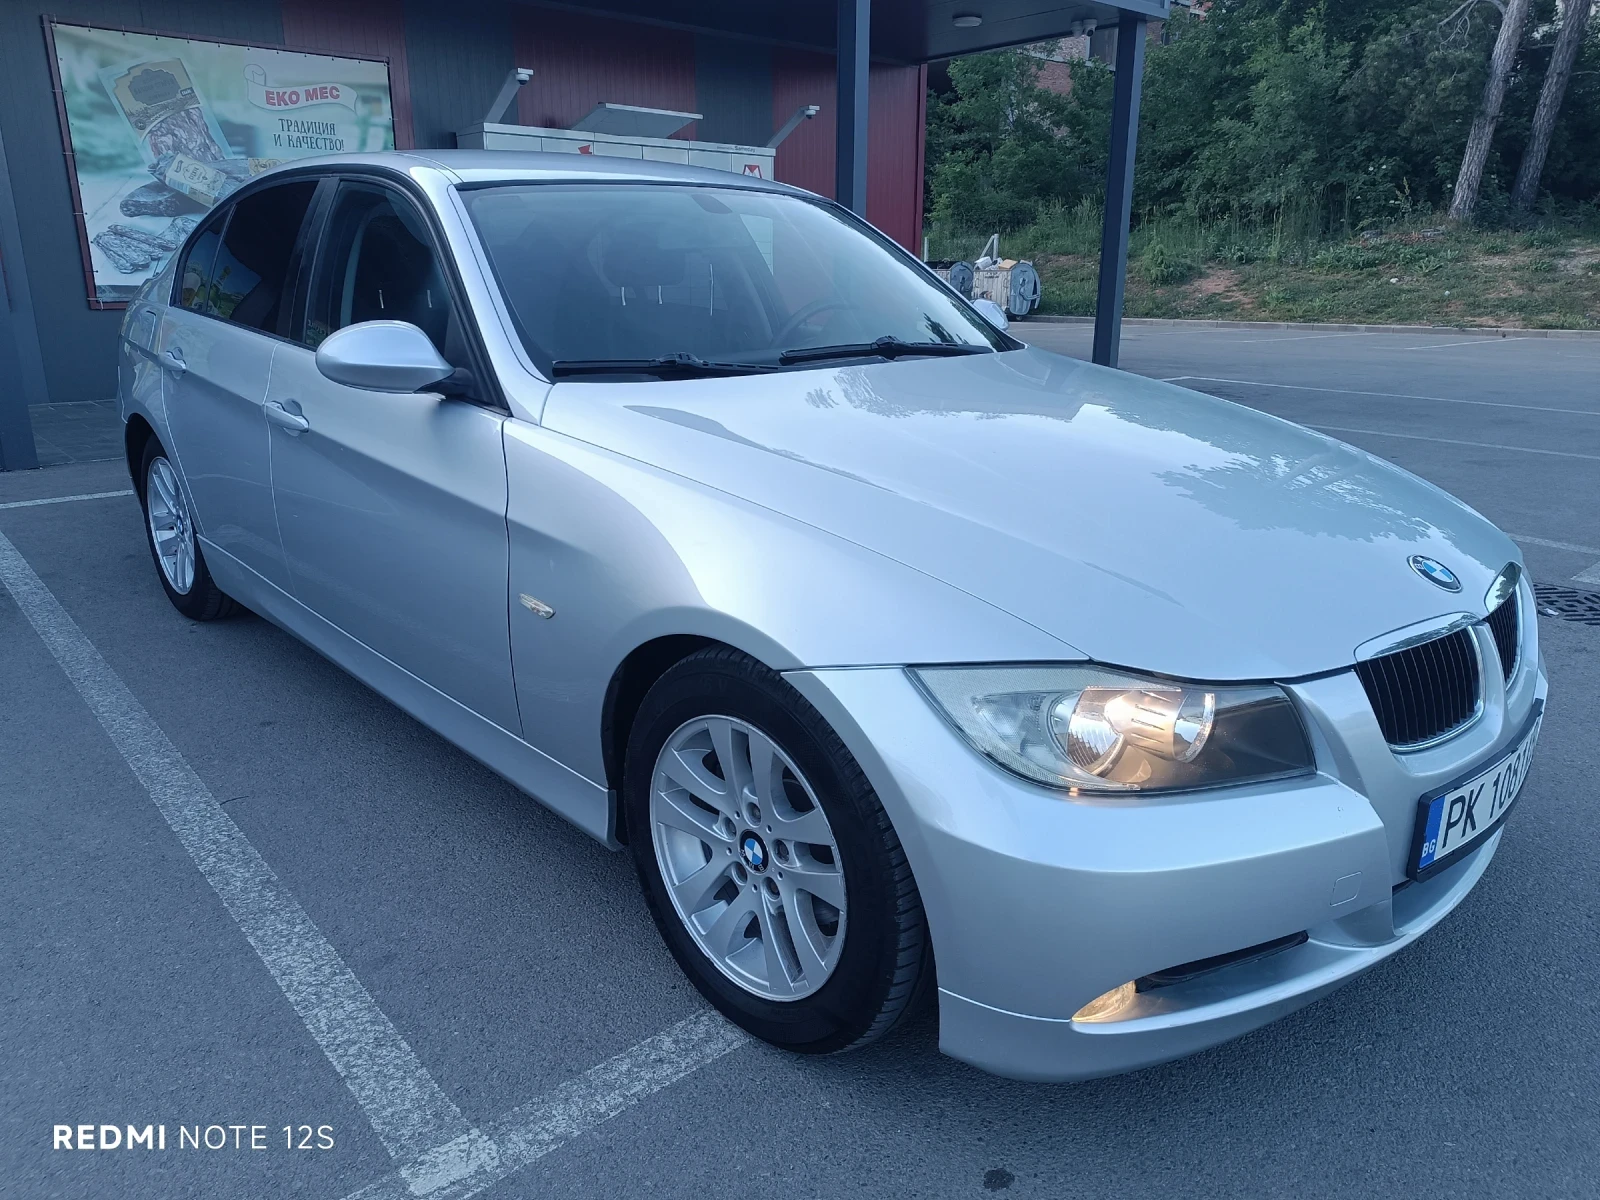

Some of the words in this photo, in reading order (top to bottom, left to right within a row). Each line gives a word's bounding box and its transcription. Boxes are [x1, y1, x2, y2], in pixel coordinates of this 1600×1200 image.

[265, 90, 300, 106] ЕКО
[304, 86, 340, 102] МЕС
[278, 118, 336, 136] ТРАДИЦИЯ
[273, 134, 282, 147] И
[287, 134, 345, 151] КАЧЕСТВО!
[1442, 783, 1485, 849] PK
[1421, 838, 1436, 858] BG
